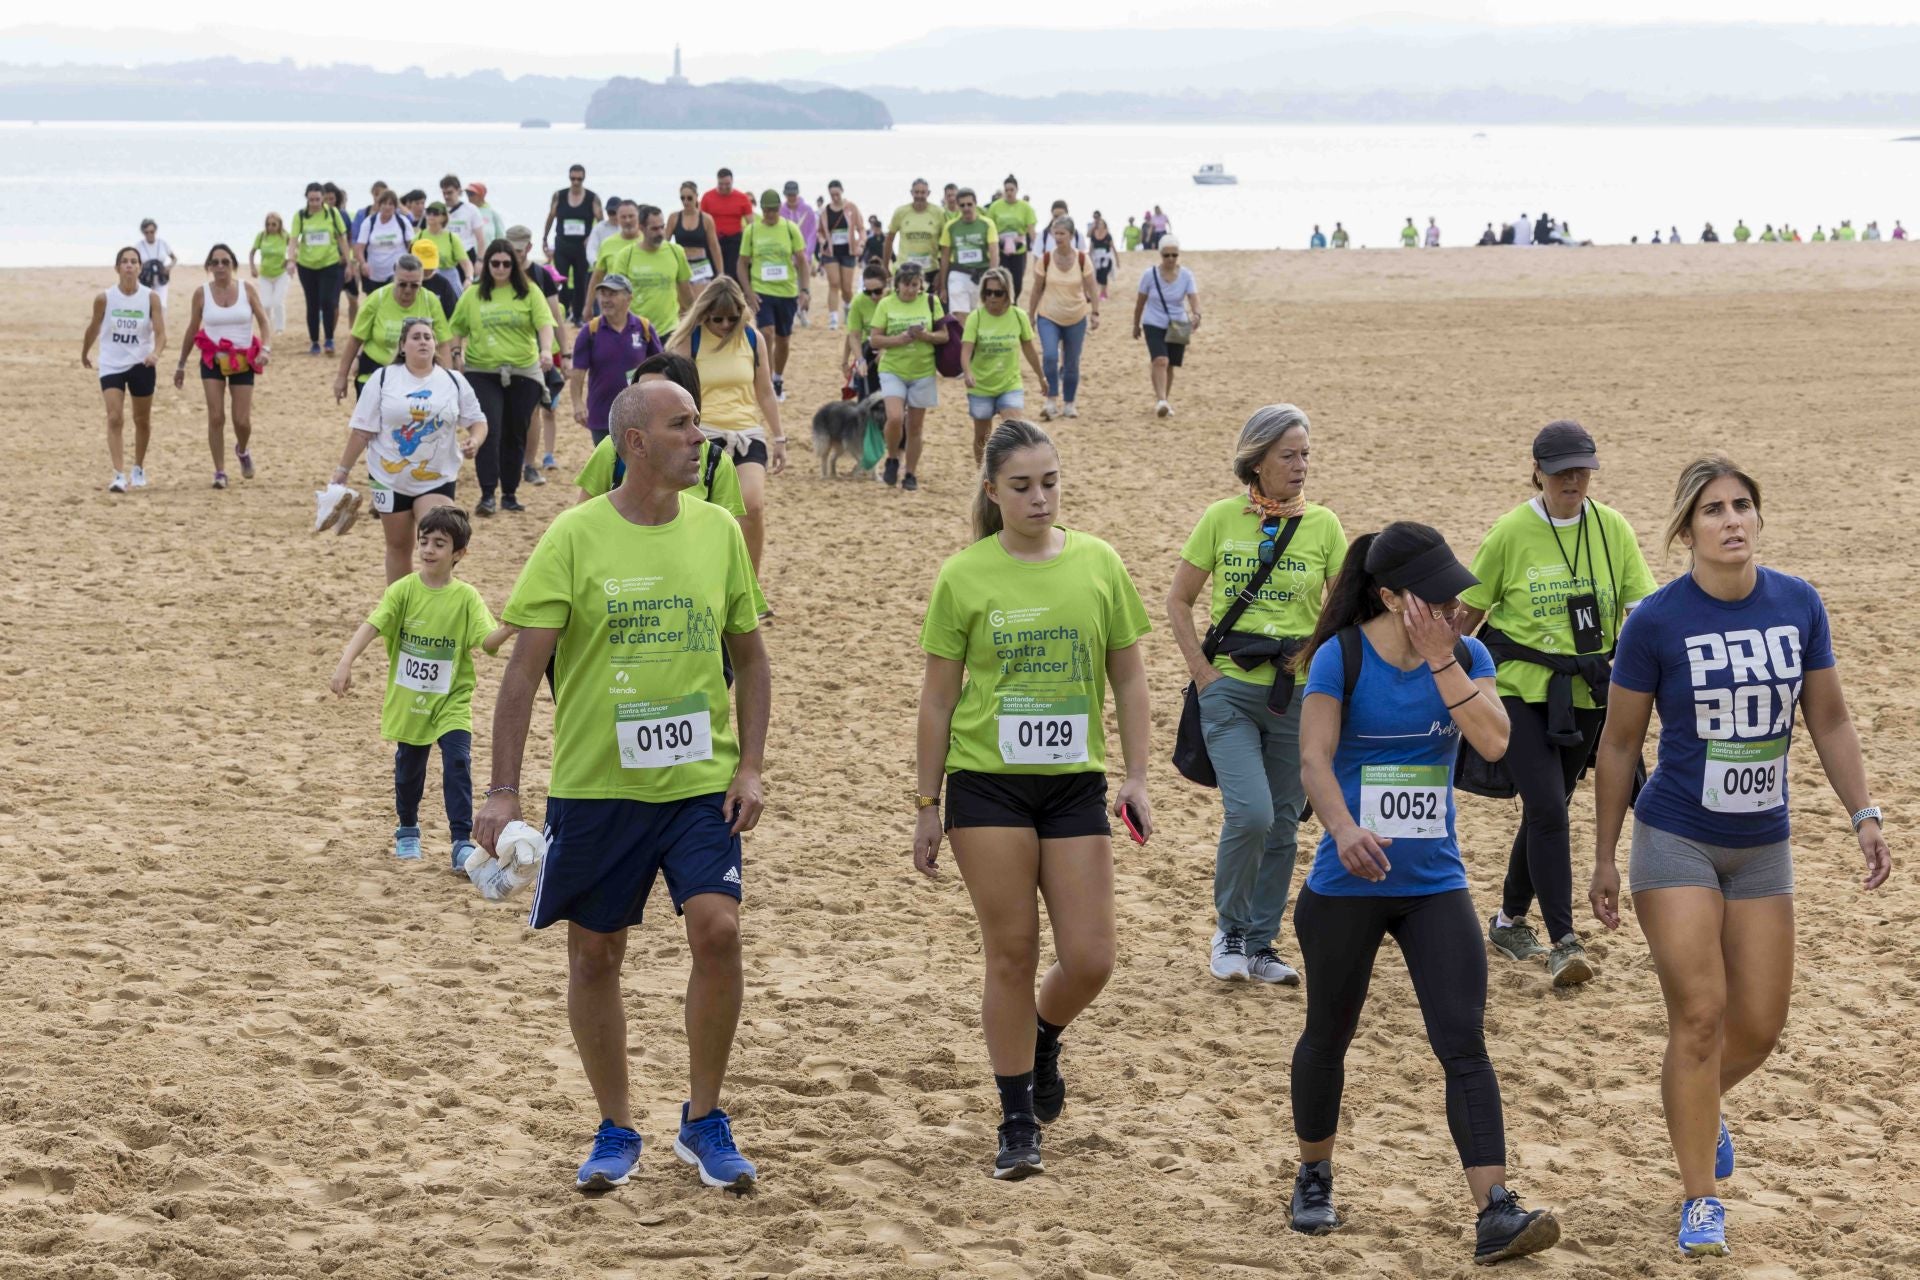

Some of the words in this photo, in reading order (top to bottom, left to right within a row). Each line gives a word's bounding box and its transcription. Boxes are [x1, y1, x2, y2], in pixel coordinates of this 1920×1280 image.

[117, 319, 137, 329] 0109
[1223, 553, 1242, 567] En
[1246, 557, 1306, 572] mcha
[1224, 570, 1272, 585] conta
[1225, 585, 1239, 598] el
[1255, 589, 1295, 601] ncer
[1529, 582, 1546, 593] En
[607, 599, 628, 614] En
[632, 594, 694, 611] marcha
[1533, 605, 1547, 618] el
[607, 614, 660, 629] contra
[410, 635, 456, 648] marcha
[609, 630, 625, 644] el
[627, 629, 684, 644] cáncer
[993, 631, 1013, 646] En
[1017, 625, 1079, 642] marcha
[996, 644, 1046, 660] contra
[1684, 625, 1802, 687] PRO
[406, 658, 439, 681] 0253
[1014, 658, 1068, 673] cáncer
[617, 701, 650, 709] Santander
[647, 705, 668, 713] cáncer
[1693, 679, 1803, 740] BOX
[637, 720, 693, 752] 0130
[1018, 720, 1073, 748] 0129
[1711, 747, 1732, 755] contra
[1712, 740, 1745, 749] Santander
[1723, 765, 1776, 796] 0099
[1380, 791, 1437, 820] 0052
